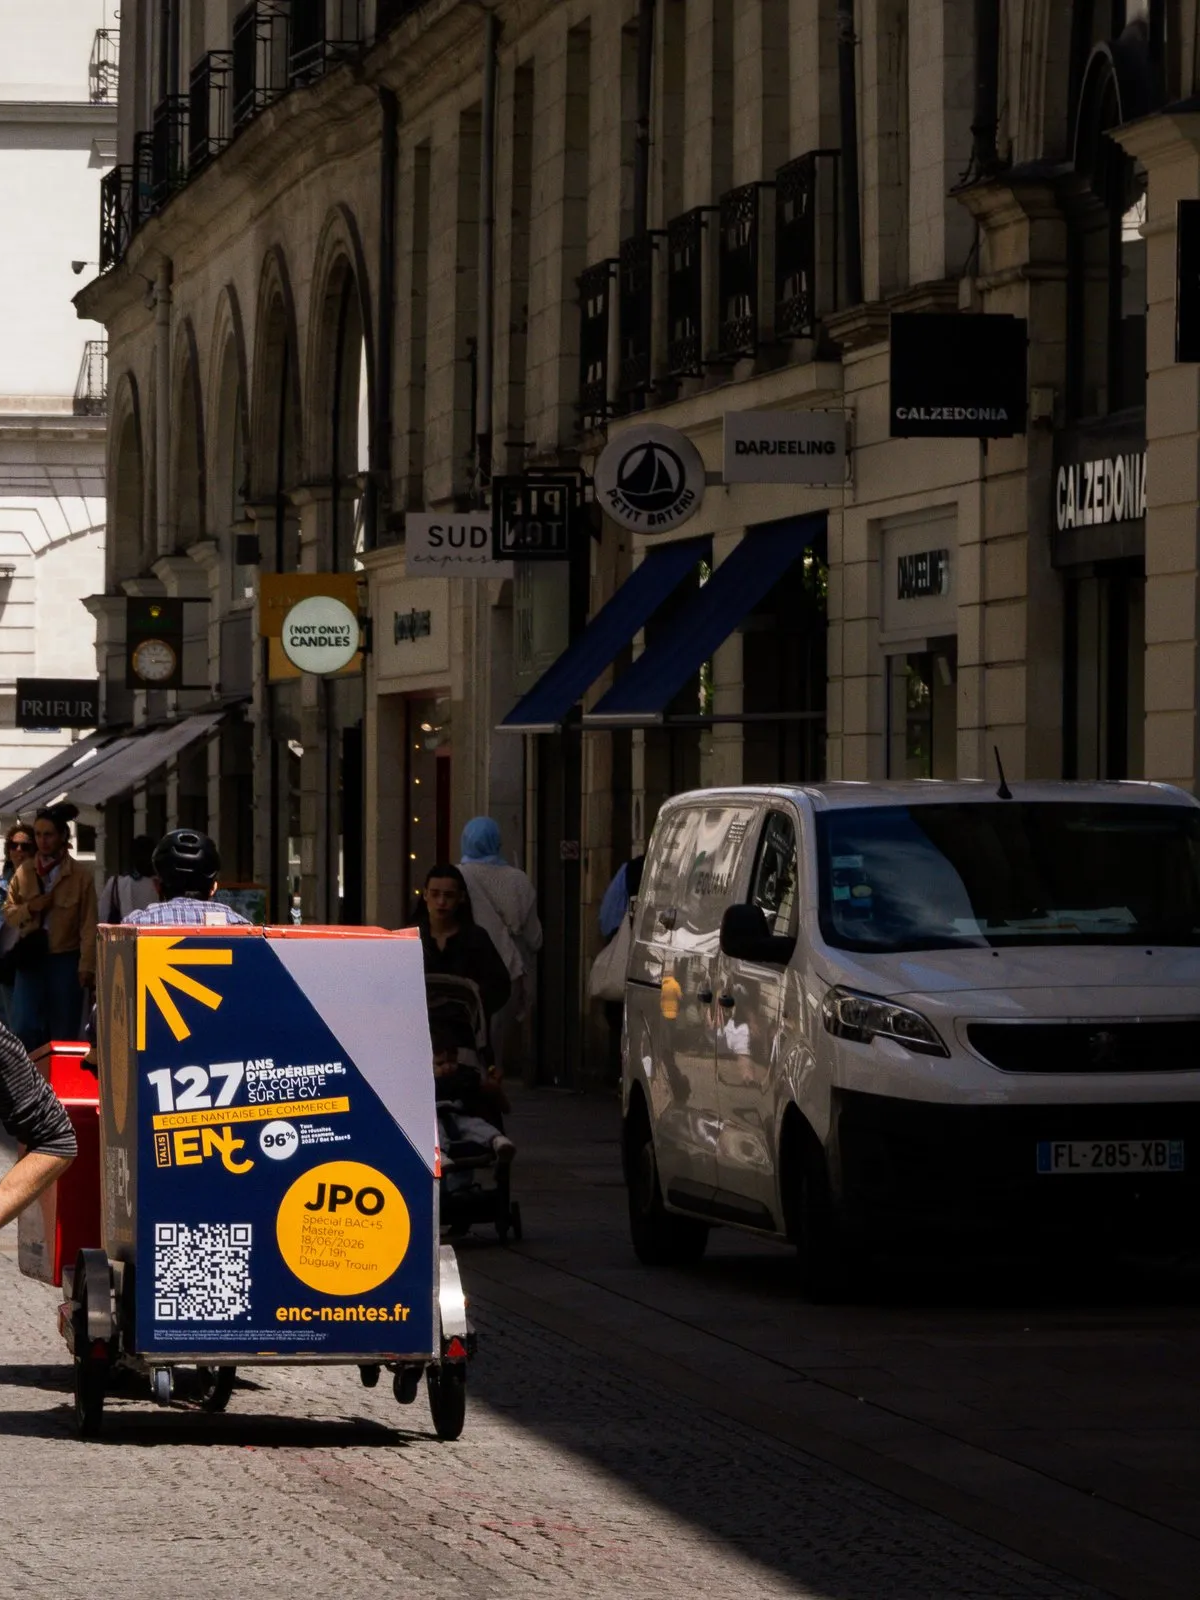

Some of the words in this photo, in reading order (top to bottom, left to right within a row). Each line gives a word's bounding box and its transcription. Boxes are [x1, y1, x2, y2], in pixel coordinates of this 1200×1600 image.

[895, 405, 1009, 421] CALZEDONIA
[735, 440, 836, 455] DARJEELING
[606, 488, 641, 522] PETIT
[647, 488, 695, 525] BATEAU
[413, 554, 501, 568] expres
[290, 625, 317, 636] (NOT
[318, 625, 351, 636] ONLY)
[290, 636, 350, 647] CANDLES
[21, 699, 95, 718] PRIEUR
[245, 1059, 274, 1071] ANS
[246, 1062, 347, 1082] D'EXPÉRIENCE,
[147, 1061, 244, 1112] 127
[271, 1075, 326, 1091] COMPTE
[248, 1091, 275, 1104] SUR
[279, 1088, 295, 1100] LE
[298, 1087, 321, 1098] CV.
[201, 1108, 255, 1123] NANTAISE
[259, 1106, 273, 1117] DE
[276, 1100, 339, 1115] COMMERCE
[263, 1131, 296, 1148] 96%
[157, 1136, 168, 1164] TALIS
[1054, 1142, 1166, 1168] FL-285-XB
[304, 1182, 385, 1216] JPO
[302, 1214, 342, 1227] Spécial
[345, 1218, 383, 1230] BAC+5
[301, 1225, 345, 1237] Mastère
[301, 1235, 365, 1249] 18/06/2026
[300, 1245, 317, 1256] 17h
[320, 1246, 327, 1257] /
[329, 1247, 347, 1258] 19h
[299, 1255, 341, 1270] Duguay
[345, 1259, 378, 1271] Trouin
[275, 1303, 410, 1322] enc-nantes.fr
